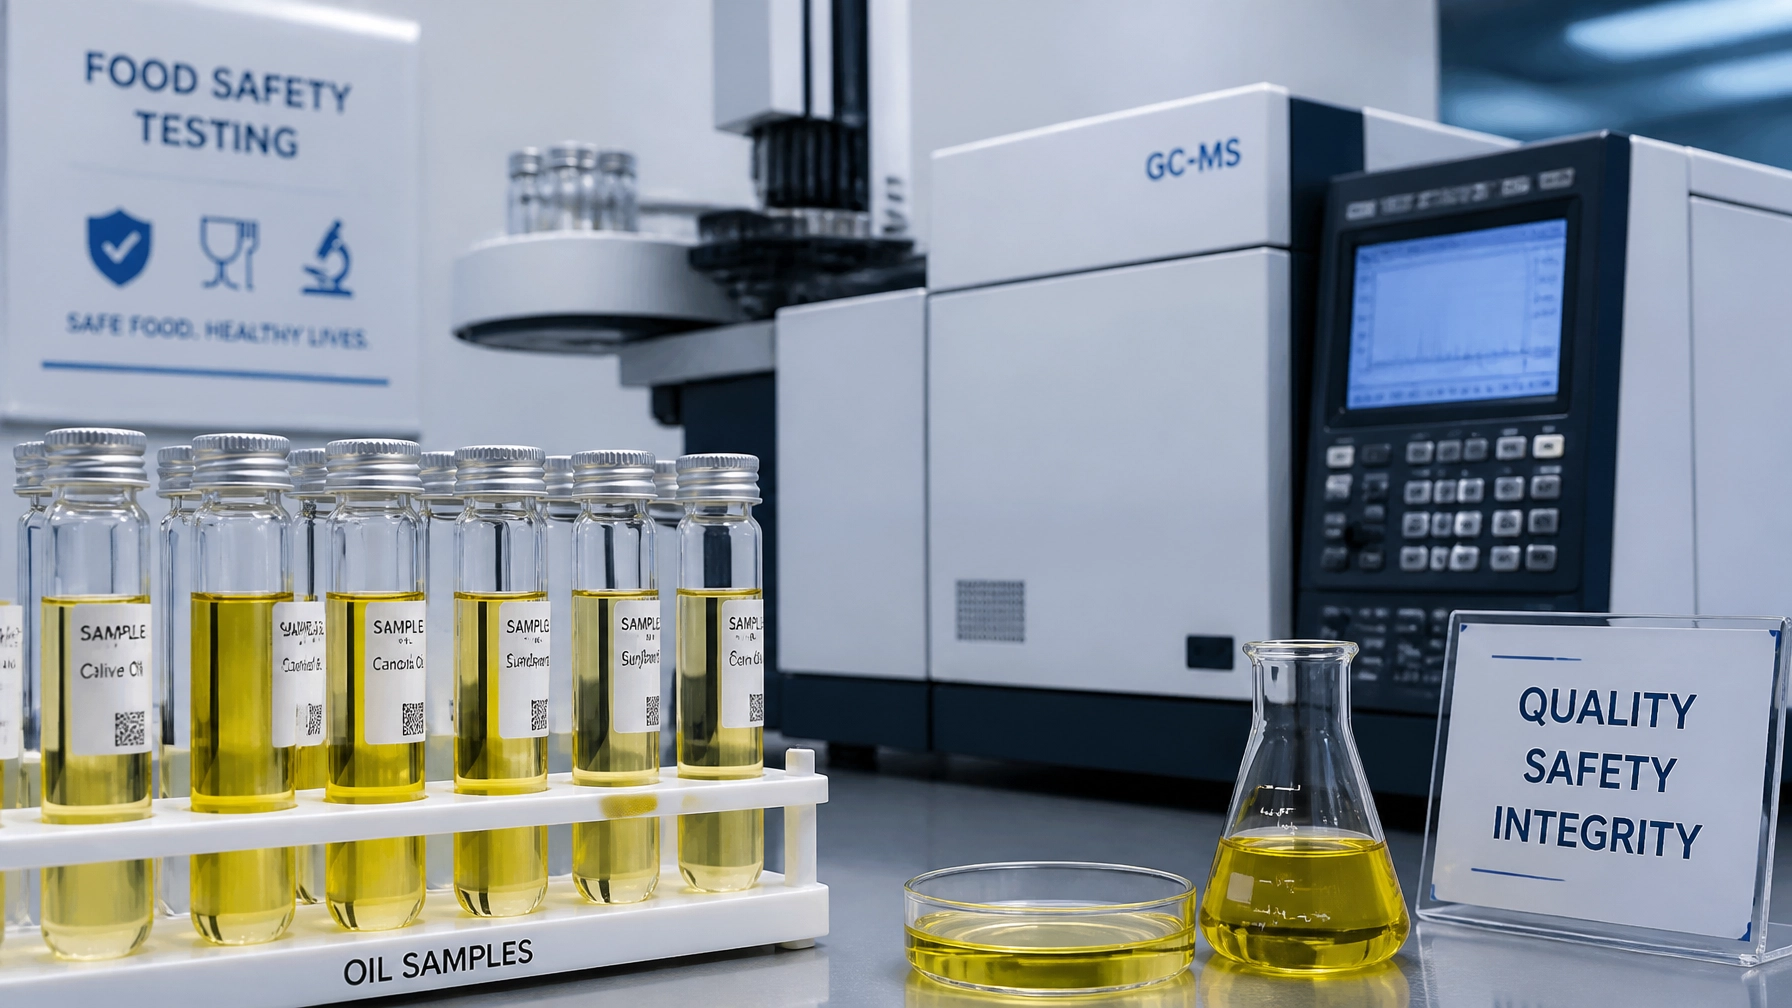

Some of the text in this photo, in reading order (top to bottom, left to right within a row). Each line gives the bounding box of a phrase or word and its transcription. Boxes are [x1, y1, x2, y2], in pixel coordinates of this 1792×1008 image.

[85, 50, 352, 114] FOOD SAFETY
[135, 110, 299, 159] TESTING
[1146, 138, 1241, 180] GC-MS
[66, 312, 122, 335] SAFE
[205, 320, 303, 346] HEALTHY
[80, 624, 146, 641] SAMPLE
[373, 619, 424, 634] SAMPLE
[506, 619, 549, 633] SAMPLE
[621, 616, 660, 631] SAMPLE
[1519, 686, 1697, 730] QUALITY
[1523, 748, 1678, 793] SAFETY
[1493, 805, 1703, 860] INTEGRITY
[344, 938, 533, 987] OIL SAMPLES
